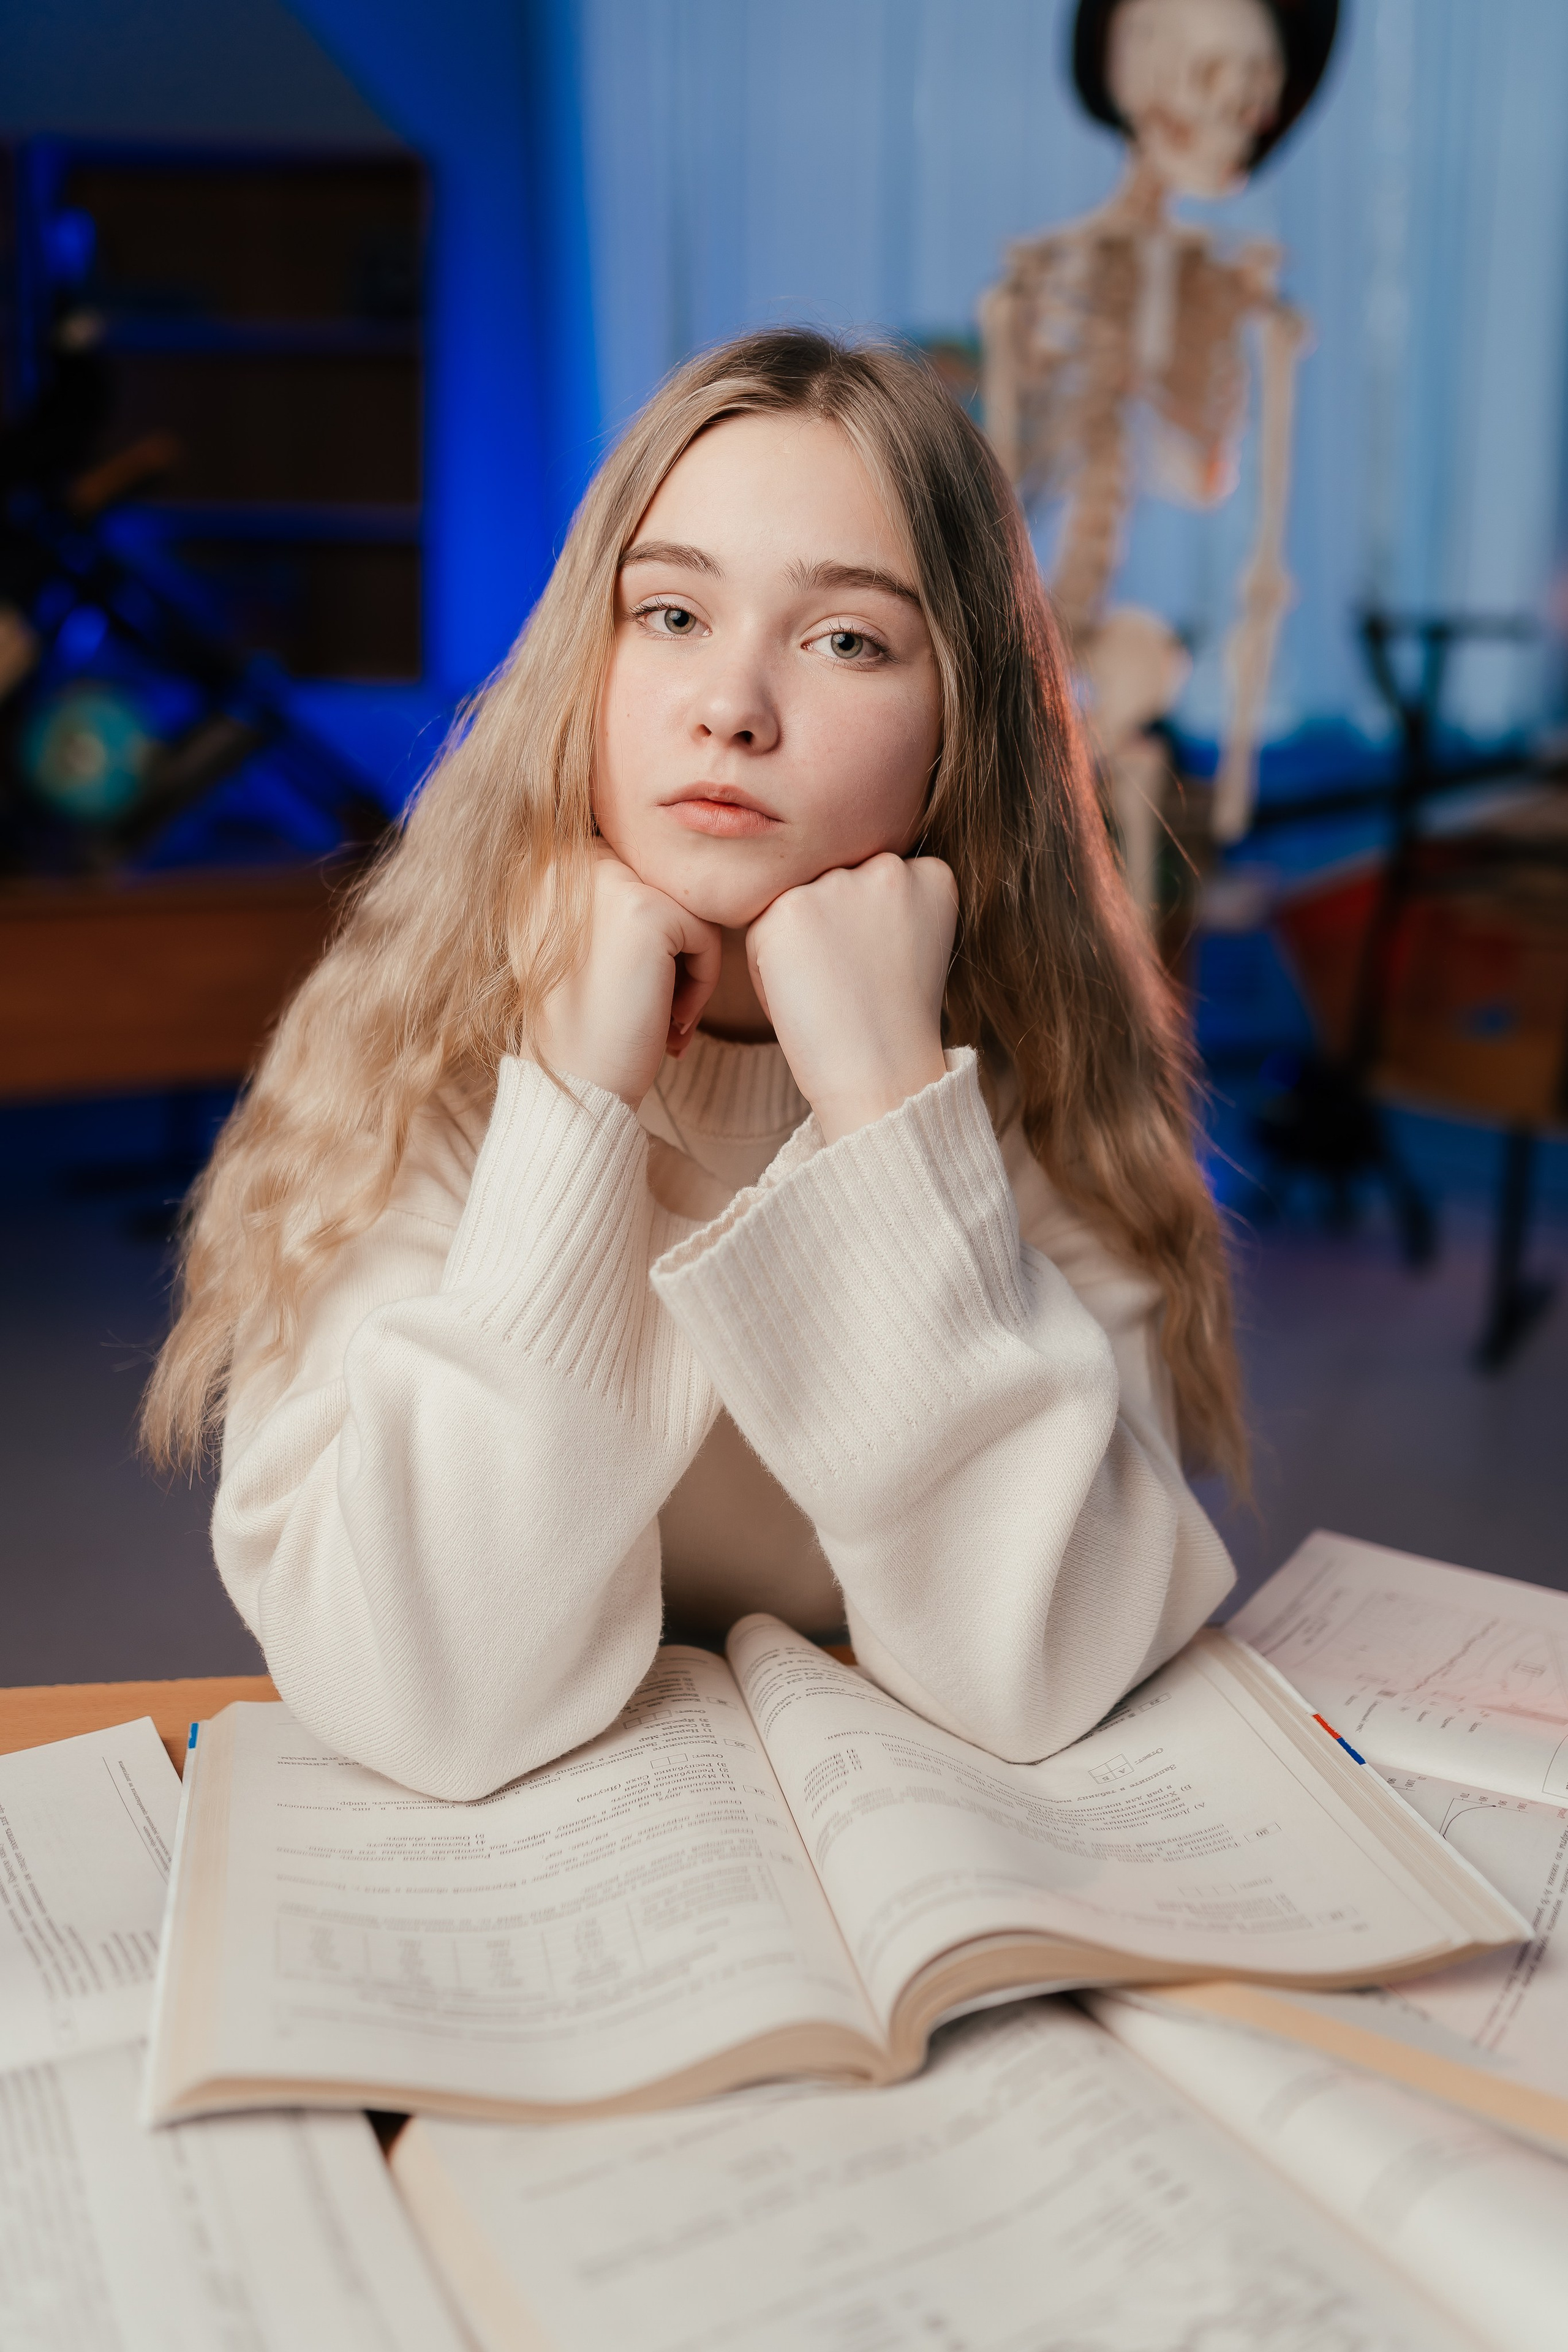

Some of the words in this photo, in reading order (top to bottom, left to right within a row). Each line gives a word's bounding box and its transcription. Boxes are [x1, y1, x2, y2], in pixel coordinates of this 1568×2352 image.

[643, 1717, 695, 1729] Ярославль
[638, 1728, 699, 1743] Нарьян-Мар
[661, 1734, 715, 1743] населения.
[823, 1730, 869, 1740] буквами.
[608, 1741, 657, 1758] Запишите
[652, 1739, 718, 1751] Расположите
[570, 1750, 643, 1776] перечисленные
[1134, 1747, 1164, 1765] Ответ:
[554, 1760, 594, 1776] таблицу
[653, 1762, 712, 1775] Республика
[655, 1768, 715, 1782] Республика
[529, 1776, 561, 1790] города
[625, 1774, 649, 1784] Саха
[653, 1773, 716, 1789] Мурманская
[1129, 1763, 1177, 1789] Запишите
[624, 1780, 650, 1790] Коми
[1405, 1779, 1416, 1788] 100
[576, 1783, 620, 1803] (Якутия)
[610, 1787, 648, 1802] область
[657, 1791, 680, 1800] двух
[1076, 1789, 1116, 1802] таблицу
[1125, 1795, 1142, 1804] для
[1139, 1790, 1177, 1807] Хочешь
[1145, 1788, 1163, 1798] рай
[275, 1802, 342, 1811] численности
[464, 1794, 506, 1809] порядке
[611, 1791, 662, 1811] Запишите
[1057, 1802, 1121, 1813] поклонников
[1193, 1801, 1206, 1810] А)
[1086, 1804, 1137, 1817] активного
[1102, 1802, 1185, 1826] многочисленных
[1109, 1796, 1181, 1821] великолепных
[1159, 1806, 1191, 1822] Добро
[556, 1814, 597, 1831] таблицу
[1088, 1820, 1148, 1832] пожаловать
[499, 1838, 545, 1855] регионов
